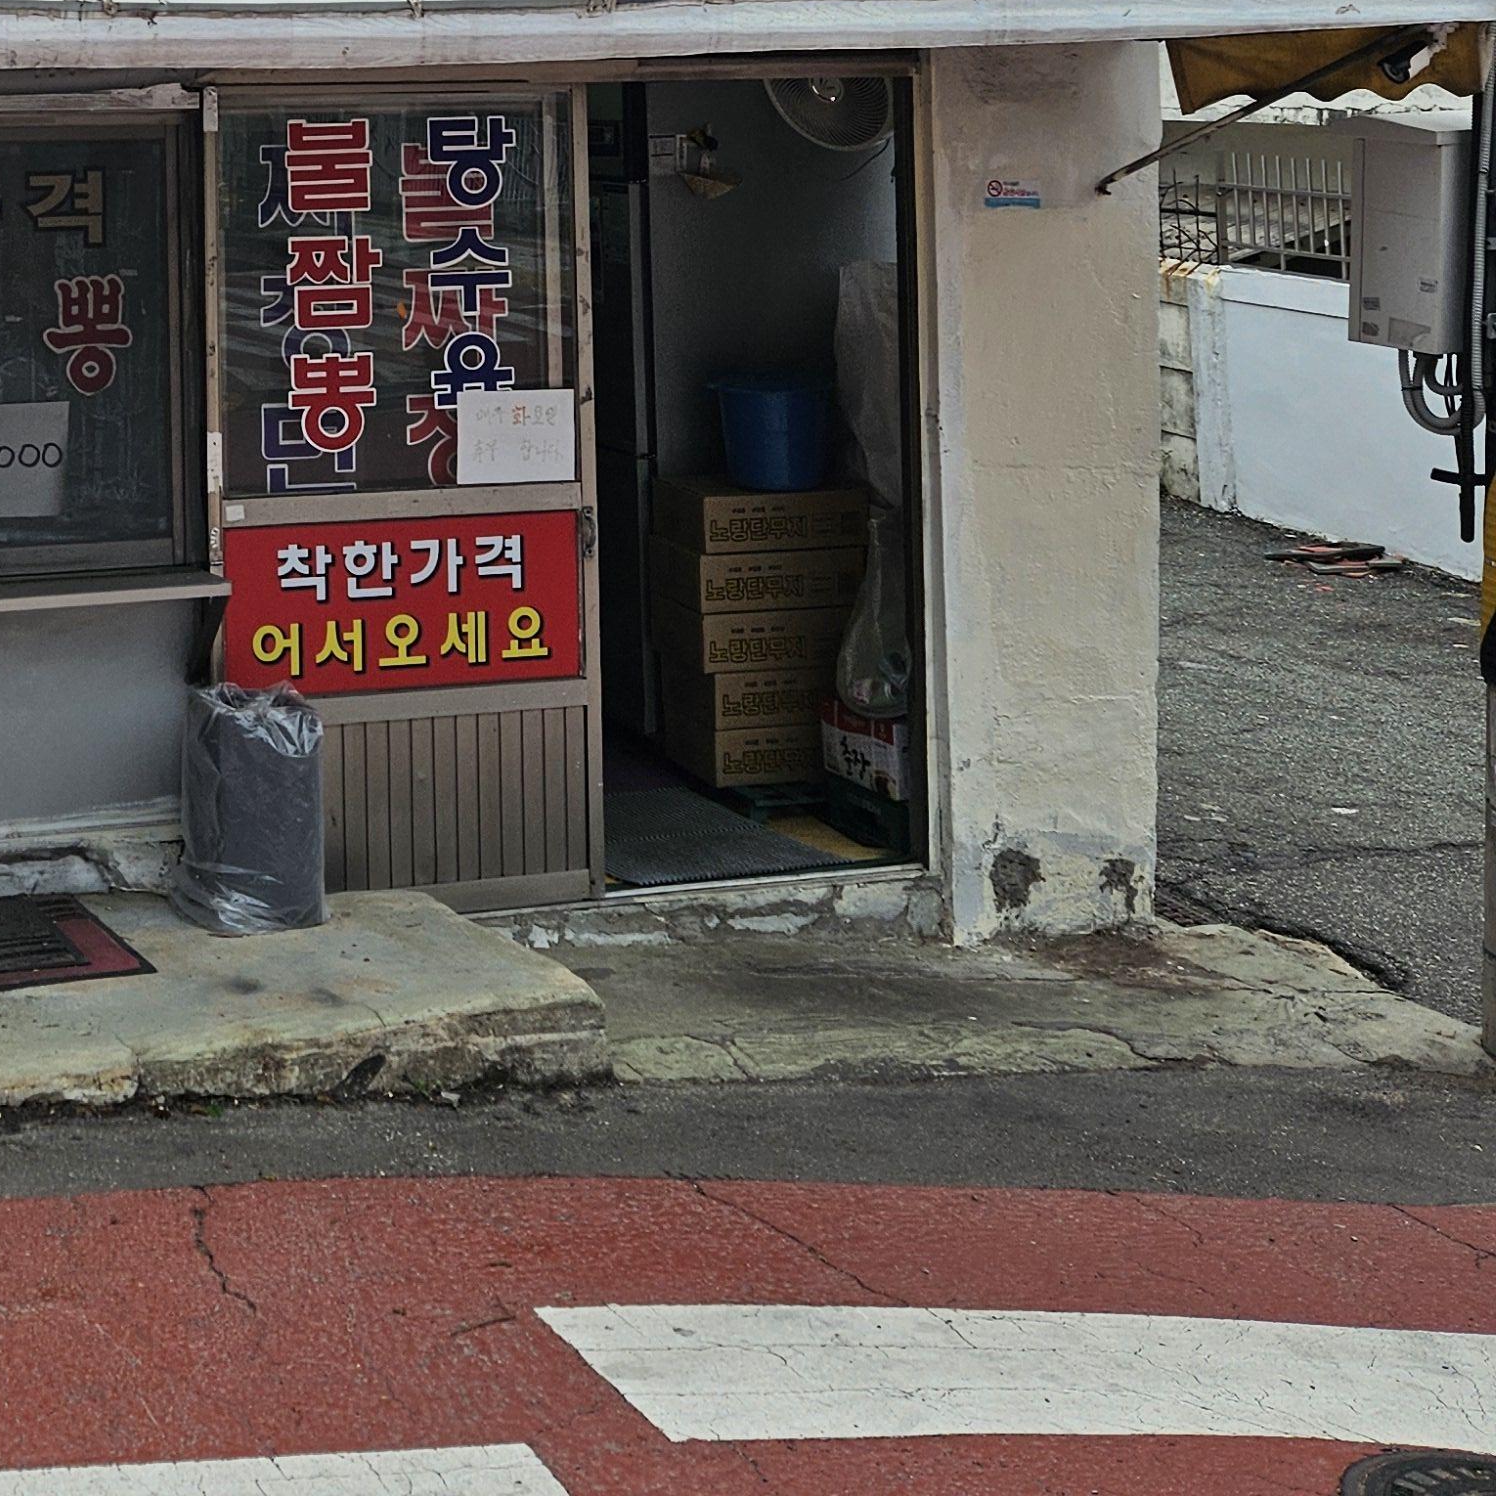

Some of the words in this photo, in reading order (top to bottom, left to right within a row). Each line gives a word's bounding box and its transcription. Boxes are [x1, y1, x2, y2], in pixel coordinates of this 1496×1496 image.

[285, 118, 382, 453] 불짬뽕
[428, 116, 516, 409] 탕수육
[709, 515, 808, 543] 노랑단무지
[705, 574, 805, 602] 노랑단무지
[252, 605, 550, 677] 어서오세요
[709, 635, 805, 663] 노랑단무지
